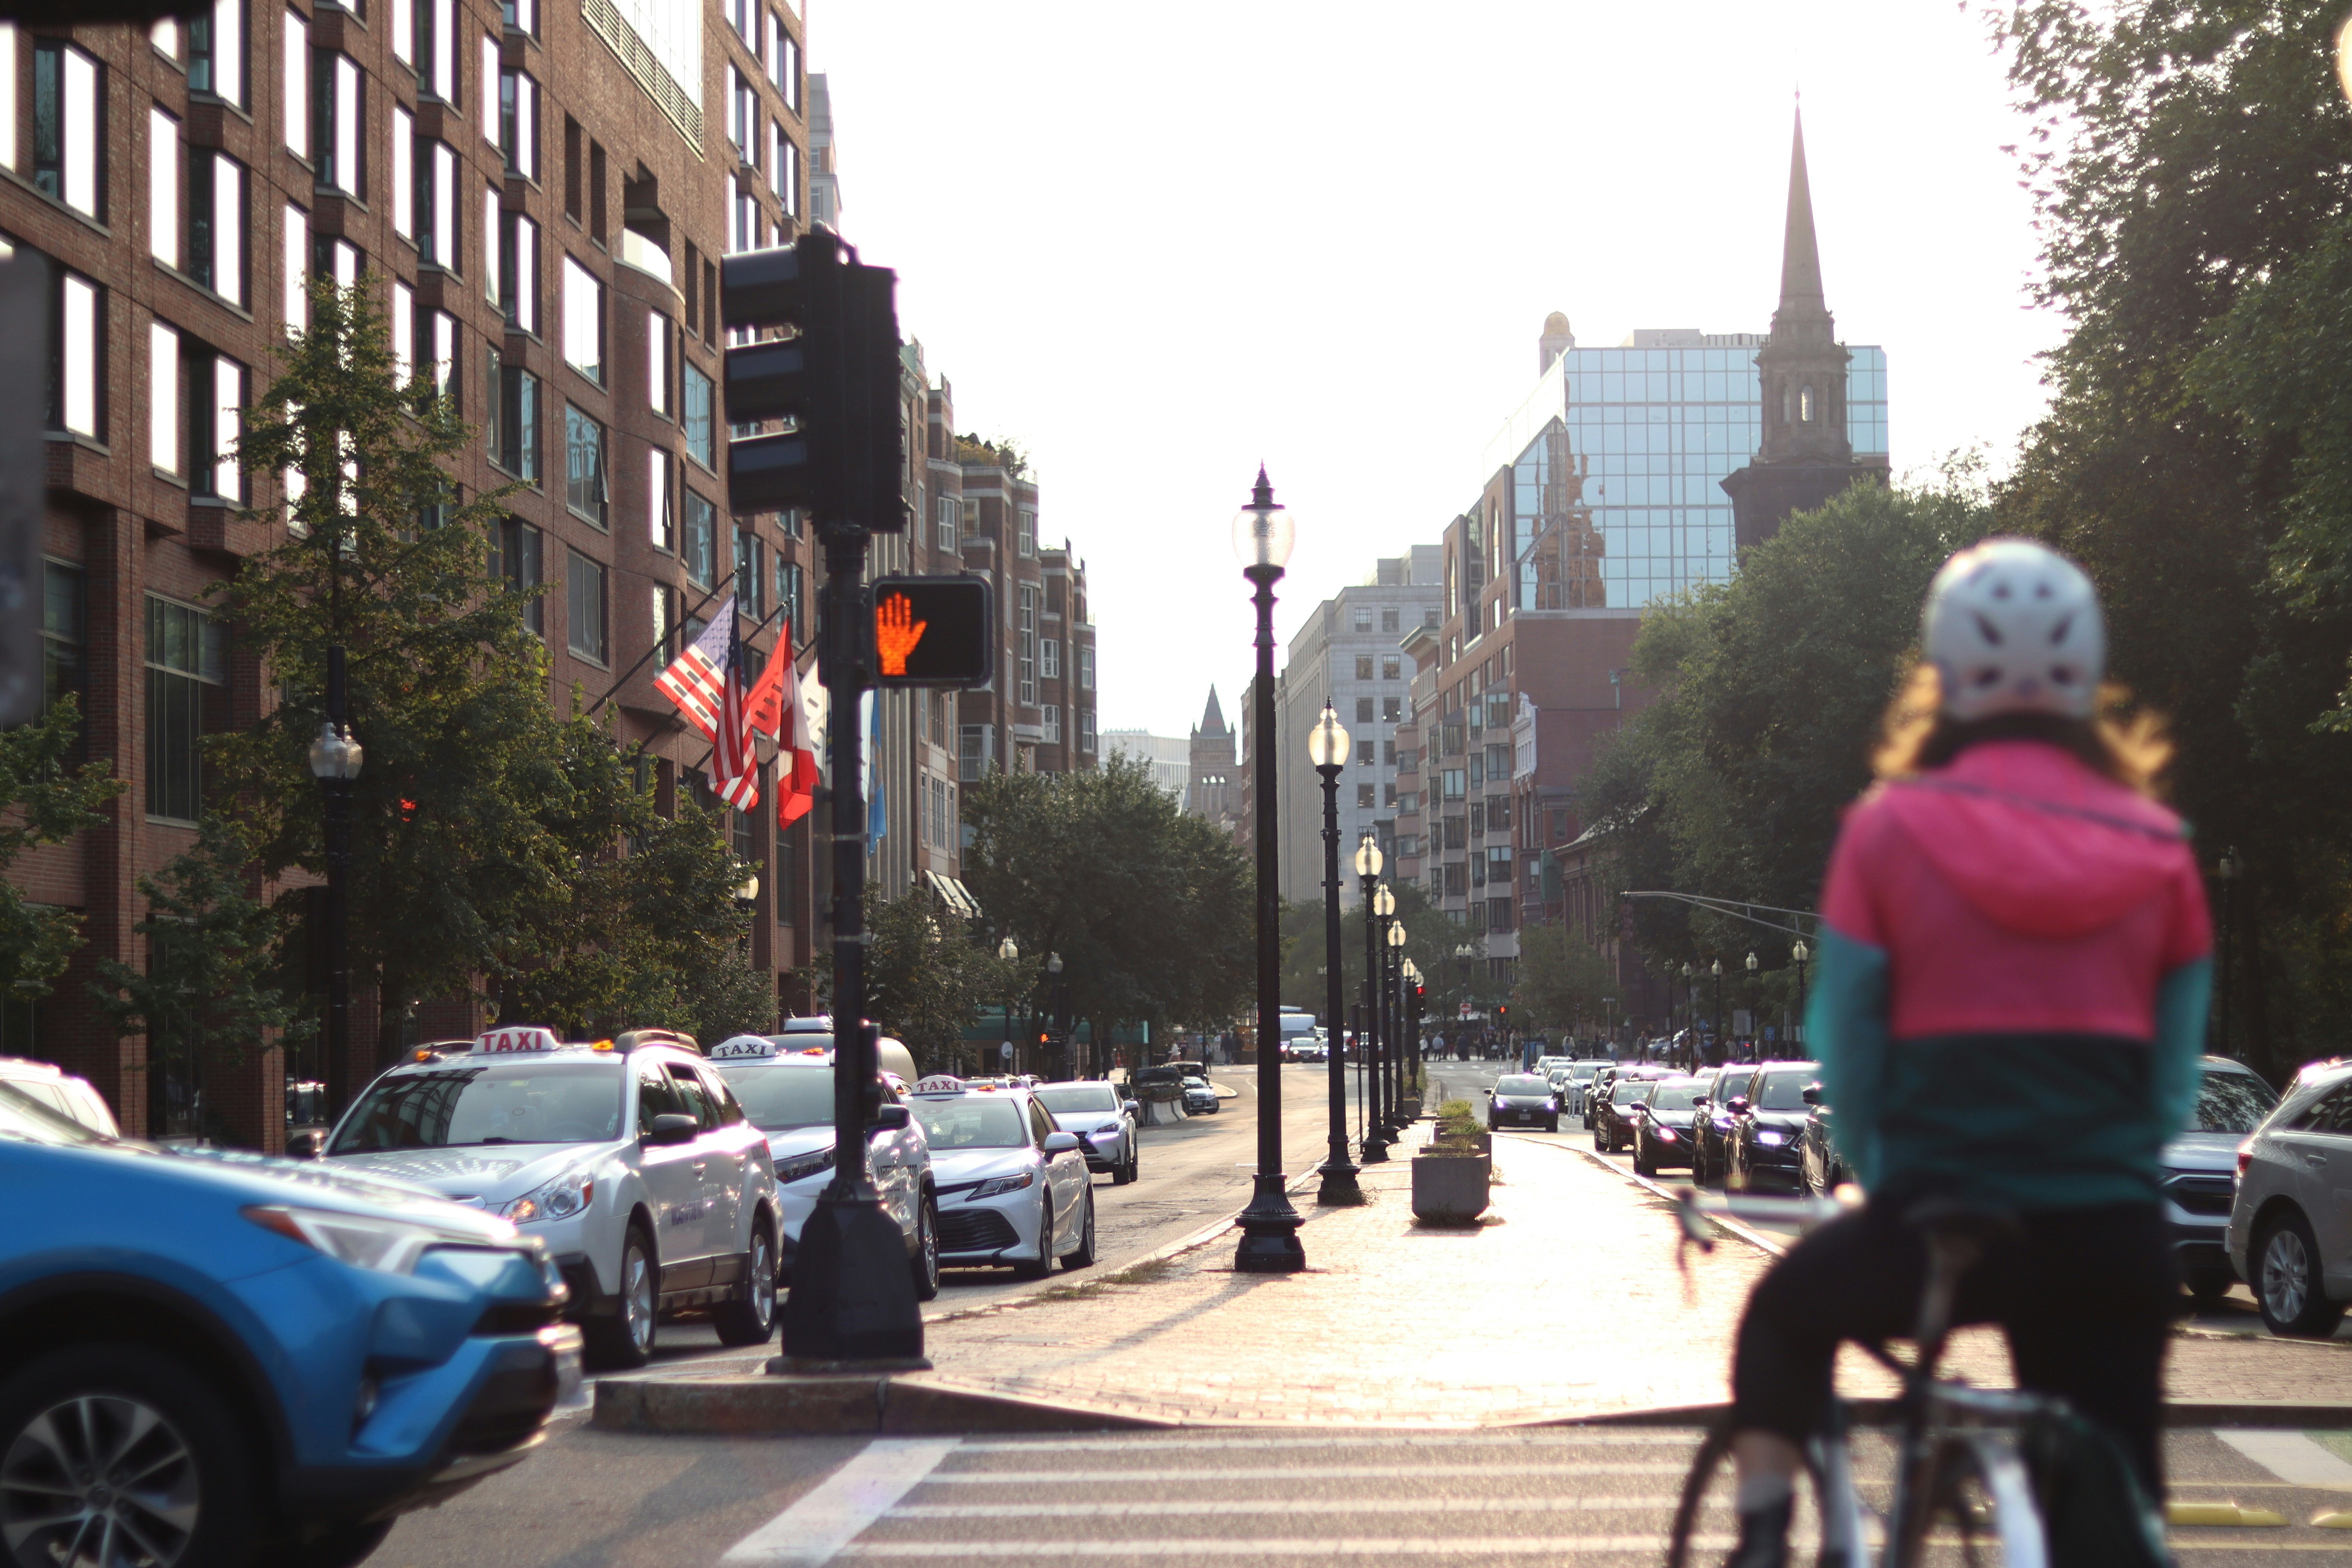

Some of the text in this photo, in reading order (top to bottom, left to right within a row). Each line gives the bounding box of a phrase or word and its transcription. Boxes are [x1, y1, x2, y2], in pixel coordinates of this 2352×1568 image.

[480, 1032, 542, 1052] TAXI
[718, 1044, 767, 1057] TAXI
[917, 1080, 959, 1093] TAXI
